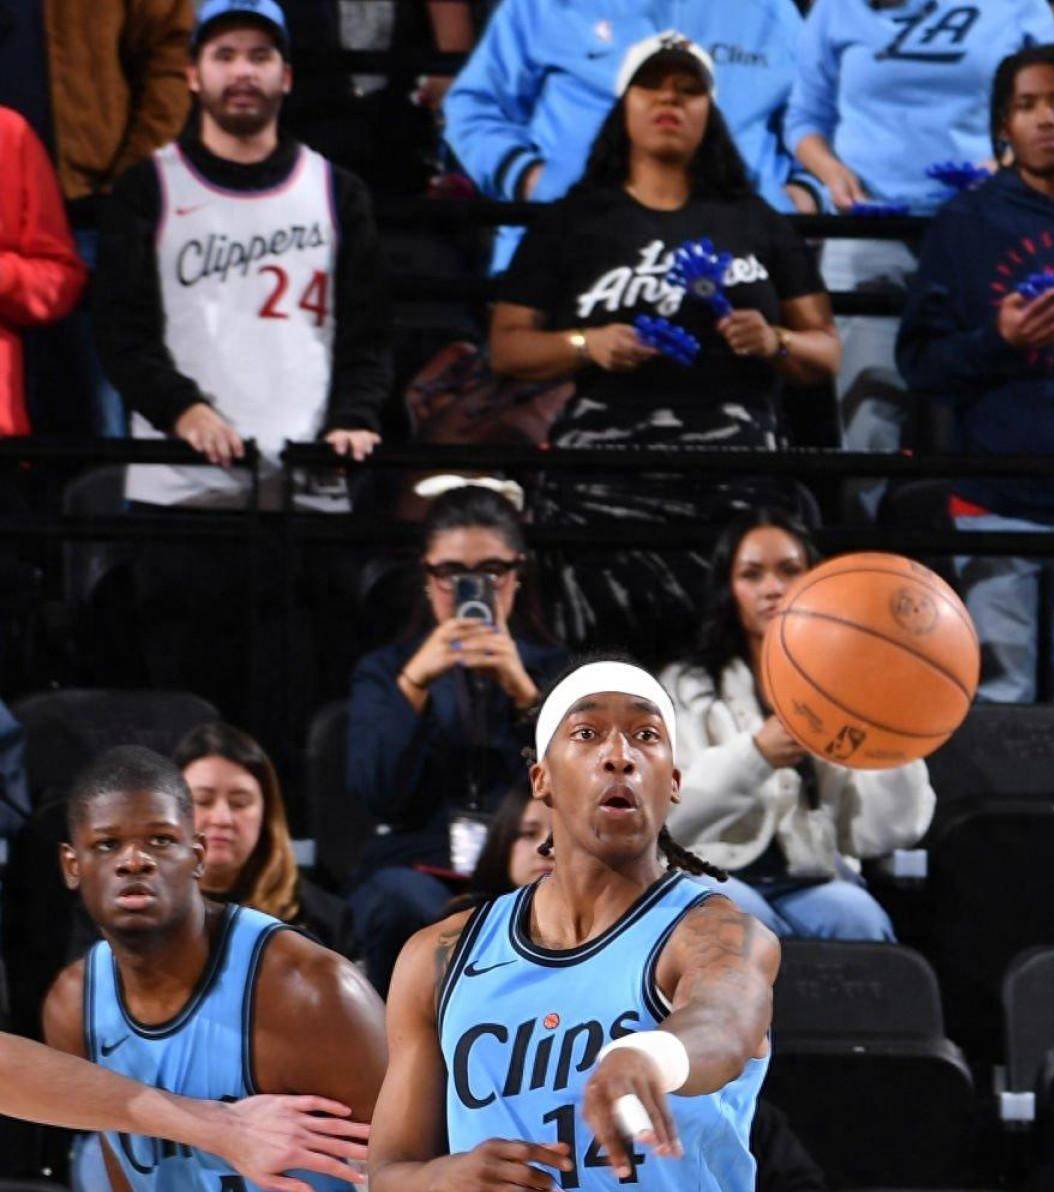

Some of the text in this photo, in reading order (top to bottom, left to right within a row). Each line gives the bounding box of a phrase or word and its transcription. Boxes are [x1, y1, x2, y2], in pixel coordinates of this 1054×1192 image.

[176, 222, 324, 286] Clippers
[577, 254, 769, 318] Anges
[258, 265, 328, 327] 24
